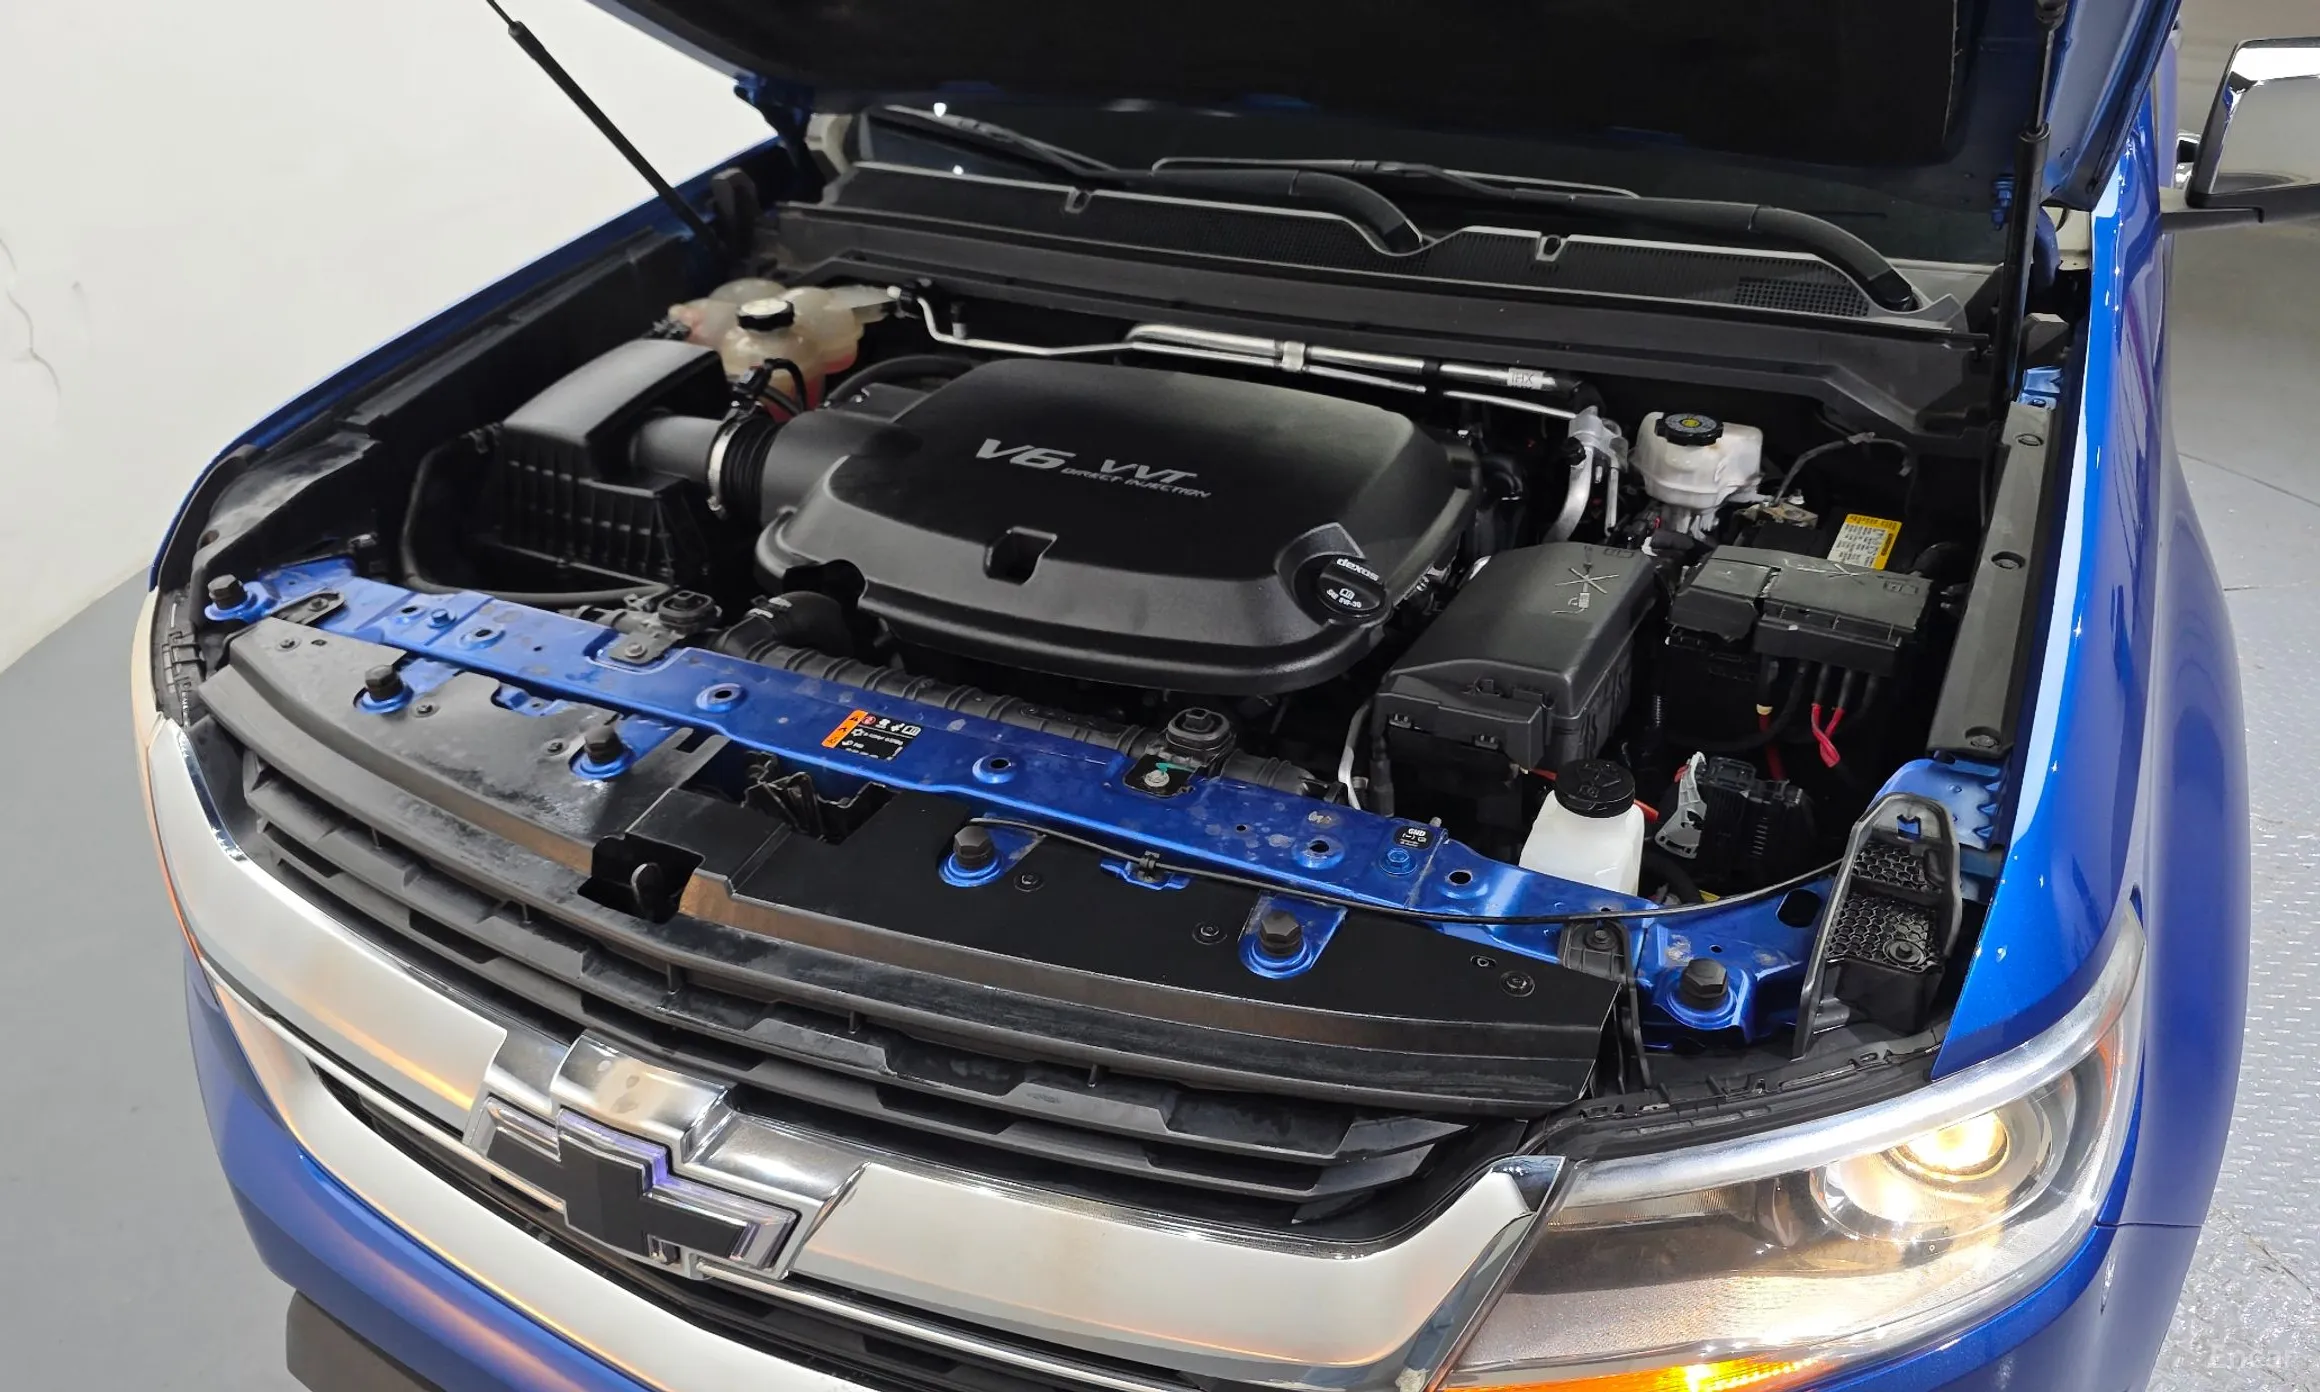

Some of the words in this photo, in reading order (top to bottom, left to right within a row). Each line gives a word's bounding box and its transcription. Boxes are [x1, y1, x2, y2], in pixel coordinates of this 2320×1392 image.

[975, 438, 1076, 469] V6
[1101, 459, 1198, 484] VVT
[1060, 467, 1123, 483] DIRECT
[1124, 478, 1211, 498] INJECTION
[1336, 558, 1379, 581] dexos
